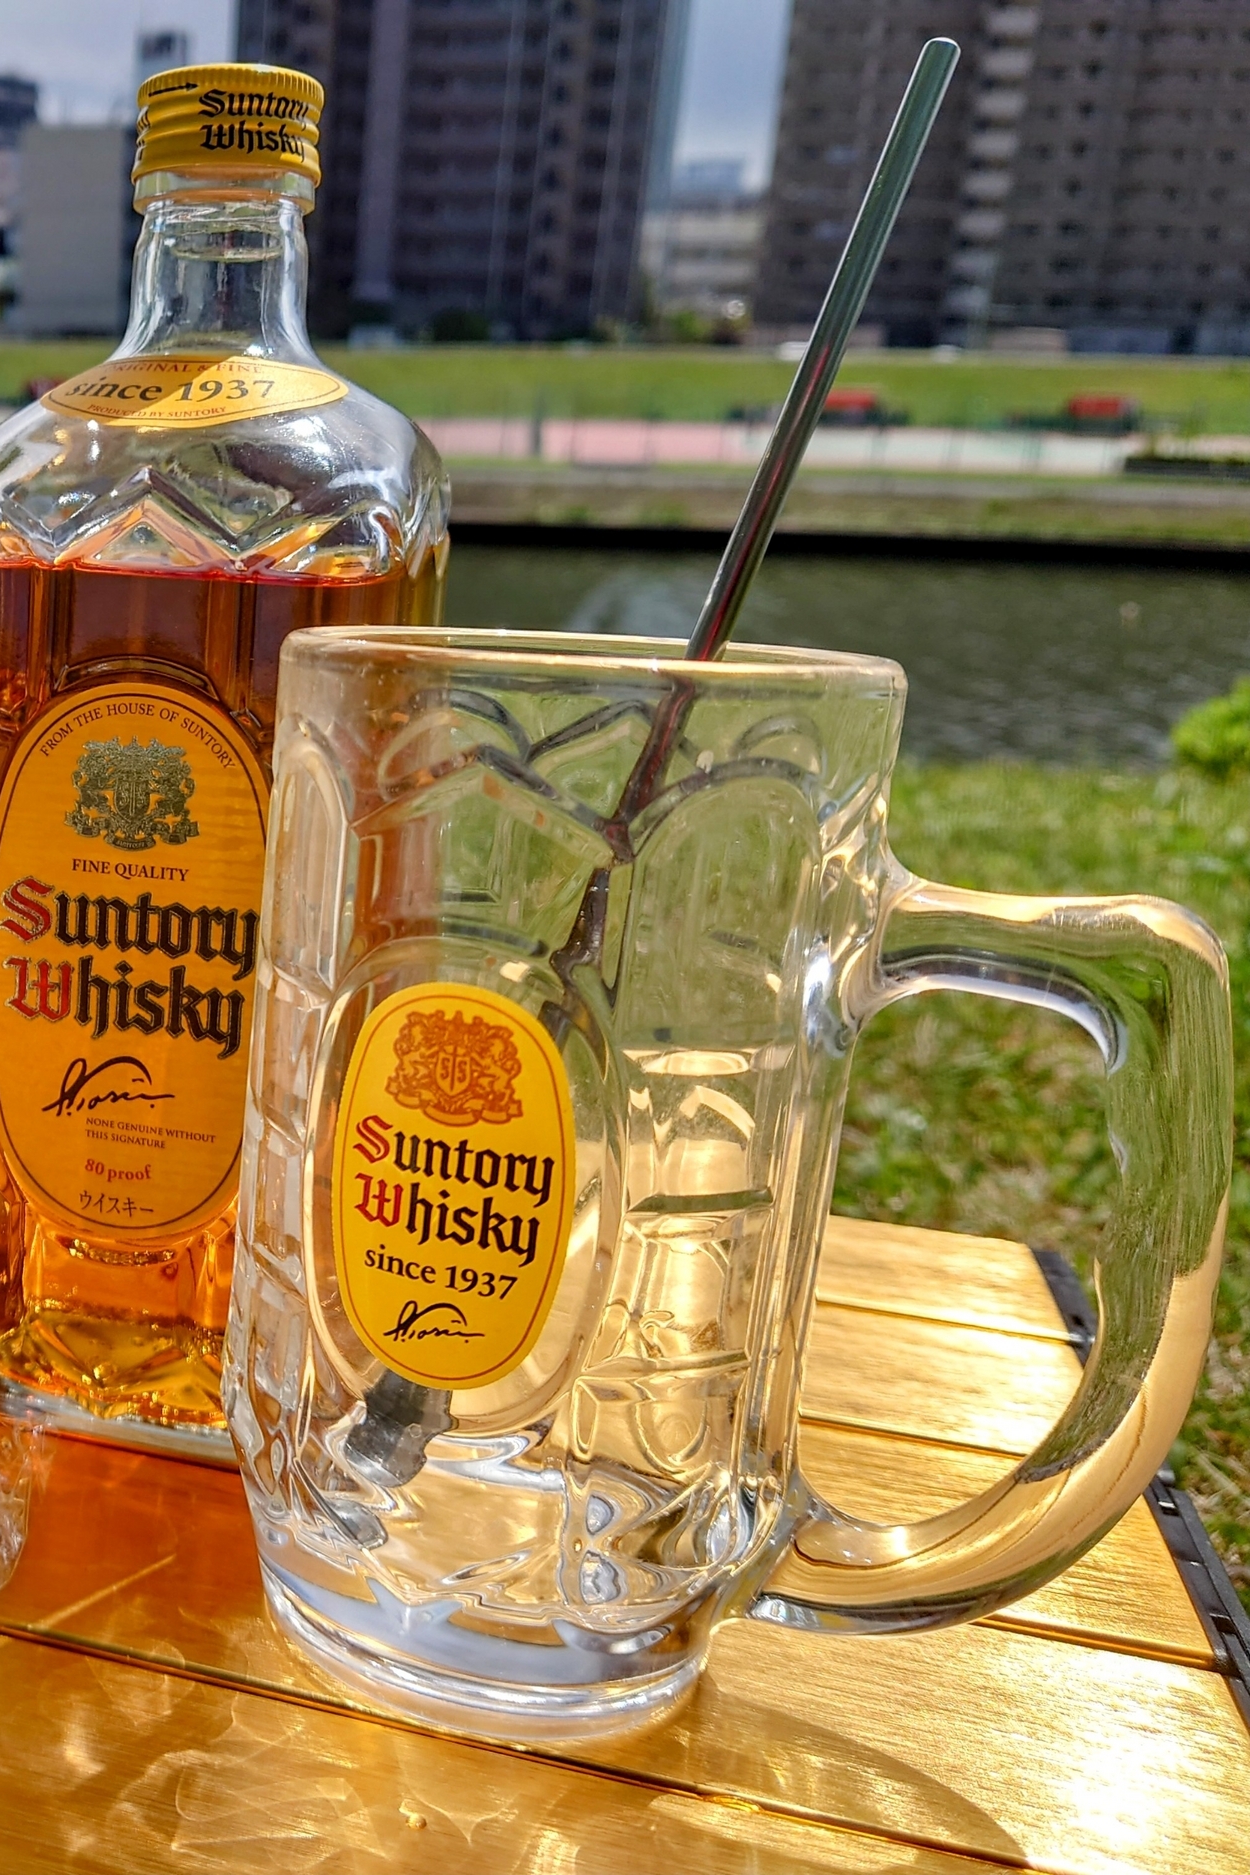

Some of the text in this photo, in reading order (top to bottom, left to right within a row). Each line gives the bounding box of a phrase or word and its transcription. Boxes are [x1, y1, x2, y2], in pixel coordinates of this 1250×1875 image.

[198, 88, 309, 131] Suntory
[200, 120, 305, 163] Whisky
[65, 376, 276, 402] since 1937
[87, 403, 228, 418] PRODUCED BY SUNTORY
[40, 702, 237, 770] FROM THE HOUSE OF SUNTORY
[72, 858, 190, 882] FINE QUALITY
[2, 955, 245, 1059] Whisky
[85, 1129, 166, 1149] THIS SIGNATURE
[86, 1117, 217, 1143] NONE GENUINE WITHOUT
[84, 1158, 152, 1183] 80 proof
[353, 1114, 555, 1208] Suntory
[79, 1190, 155, 1218] ウイスキー
[354, 1172, 540, 1268] Whisky
[364, 1244, 518, 1300] since 1937
